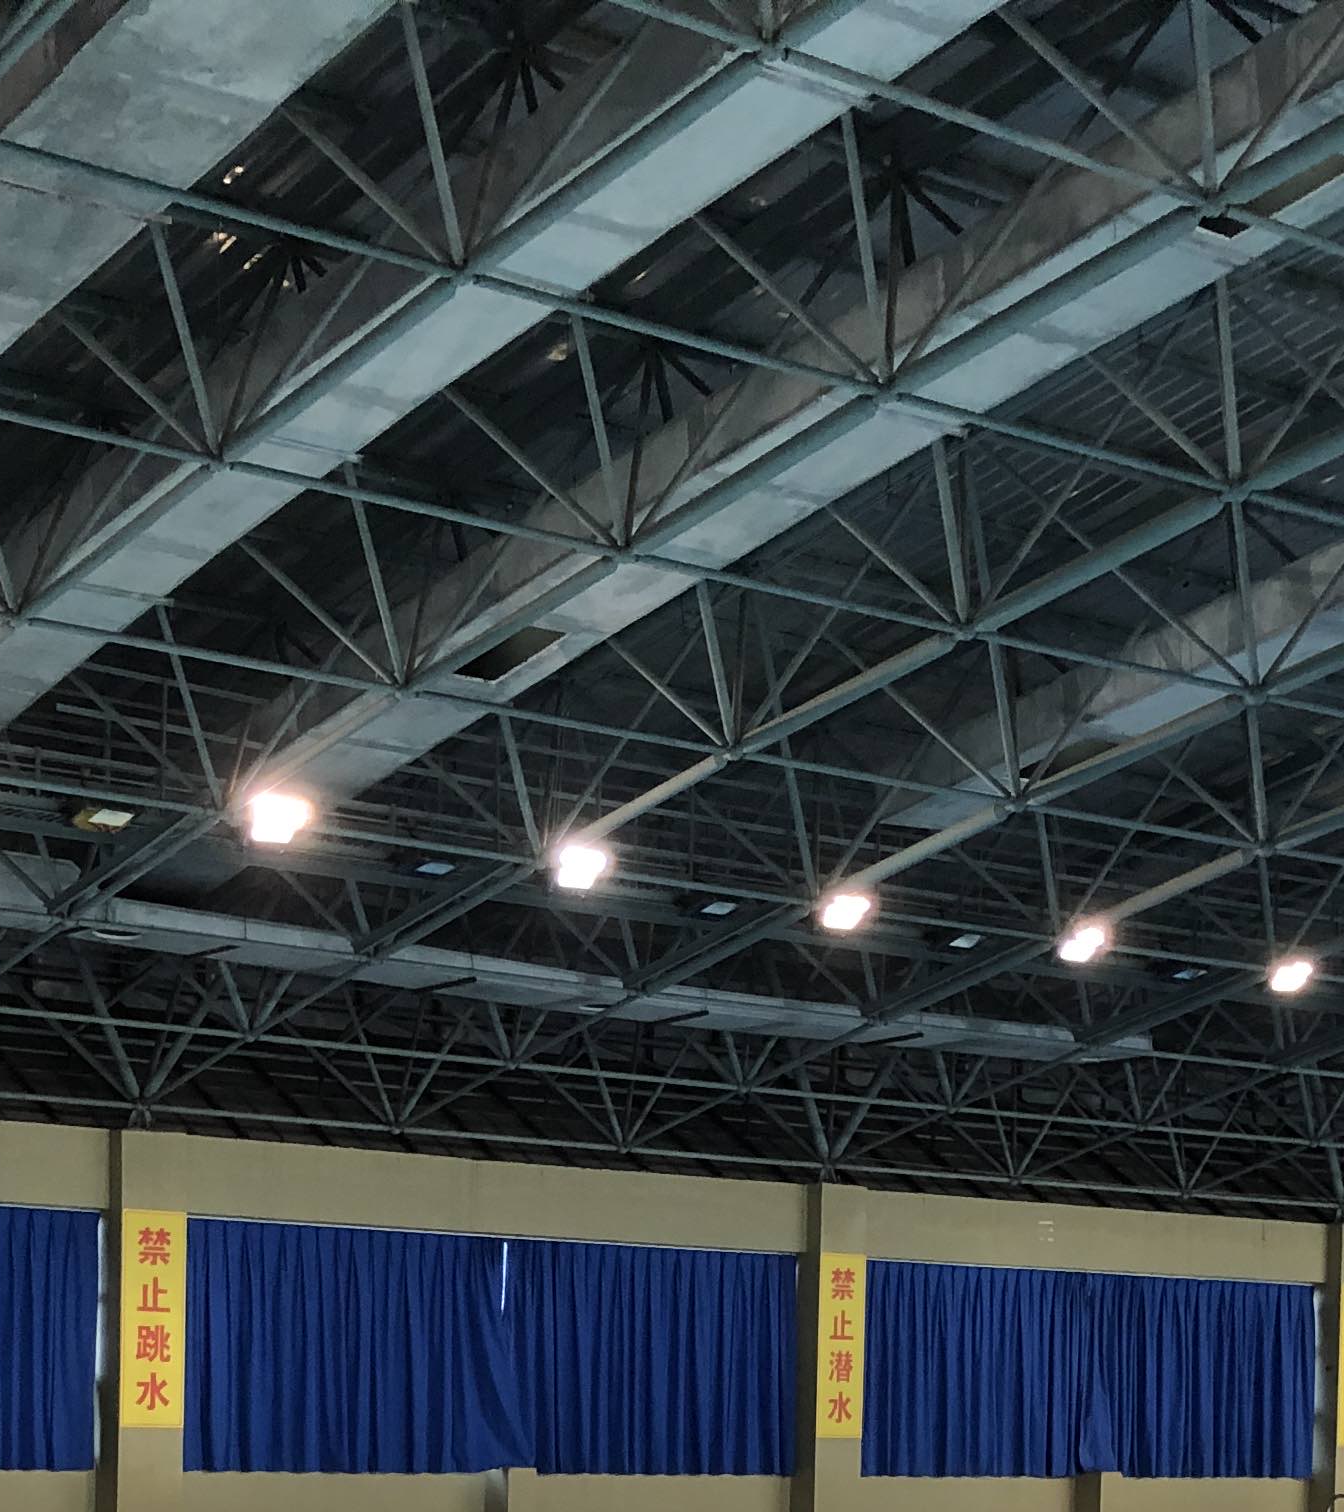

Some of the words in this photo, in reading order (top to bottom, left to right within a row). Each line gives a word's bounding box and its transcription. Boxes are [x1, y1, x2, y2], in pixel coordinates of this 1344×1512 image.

[136, 1227, 171, 1411] 禁止跳水
[827, 1268, 855, 1424] 禁止潜水
